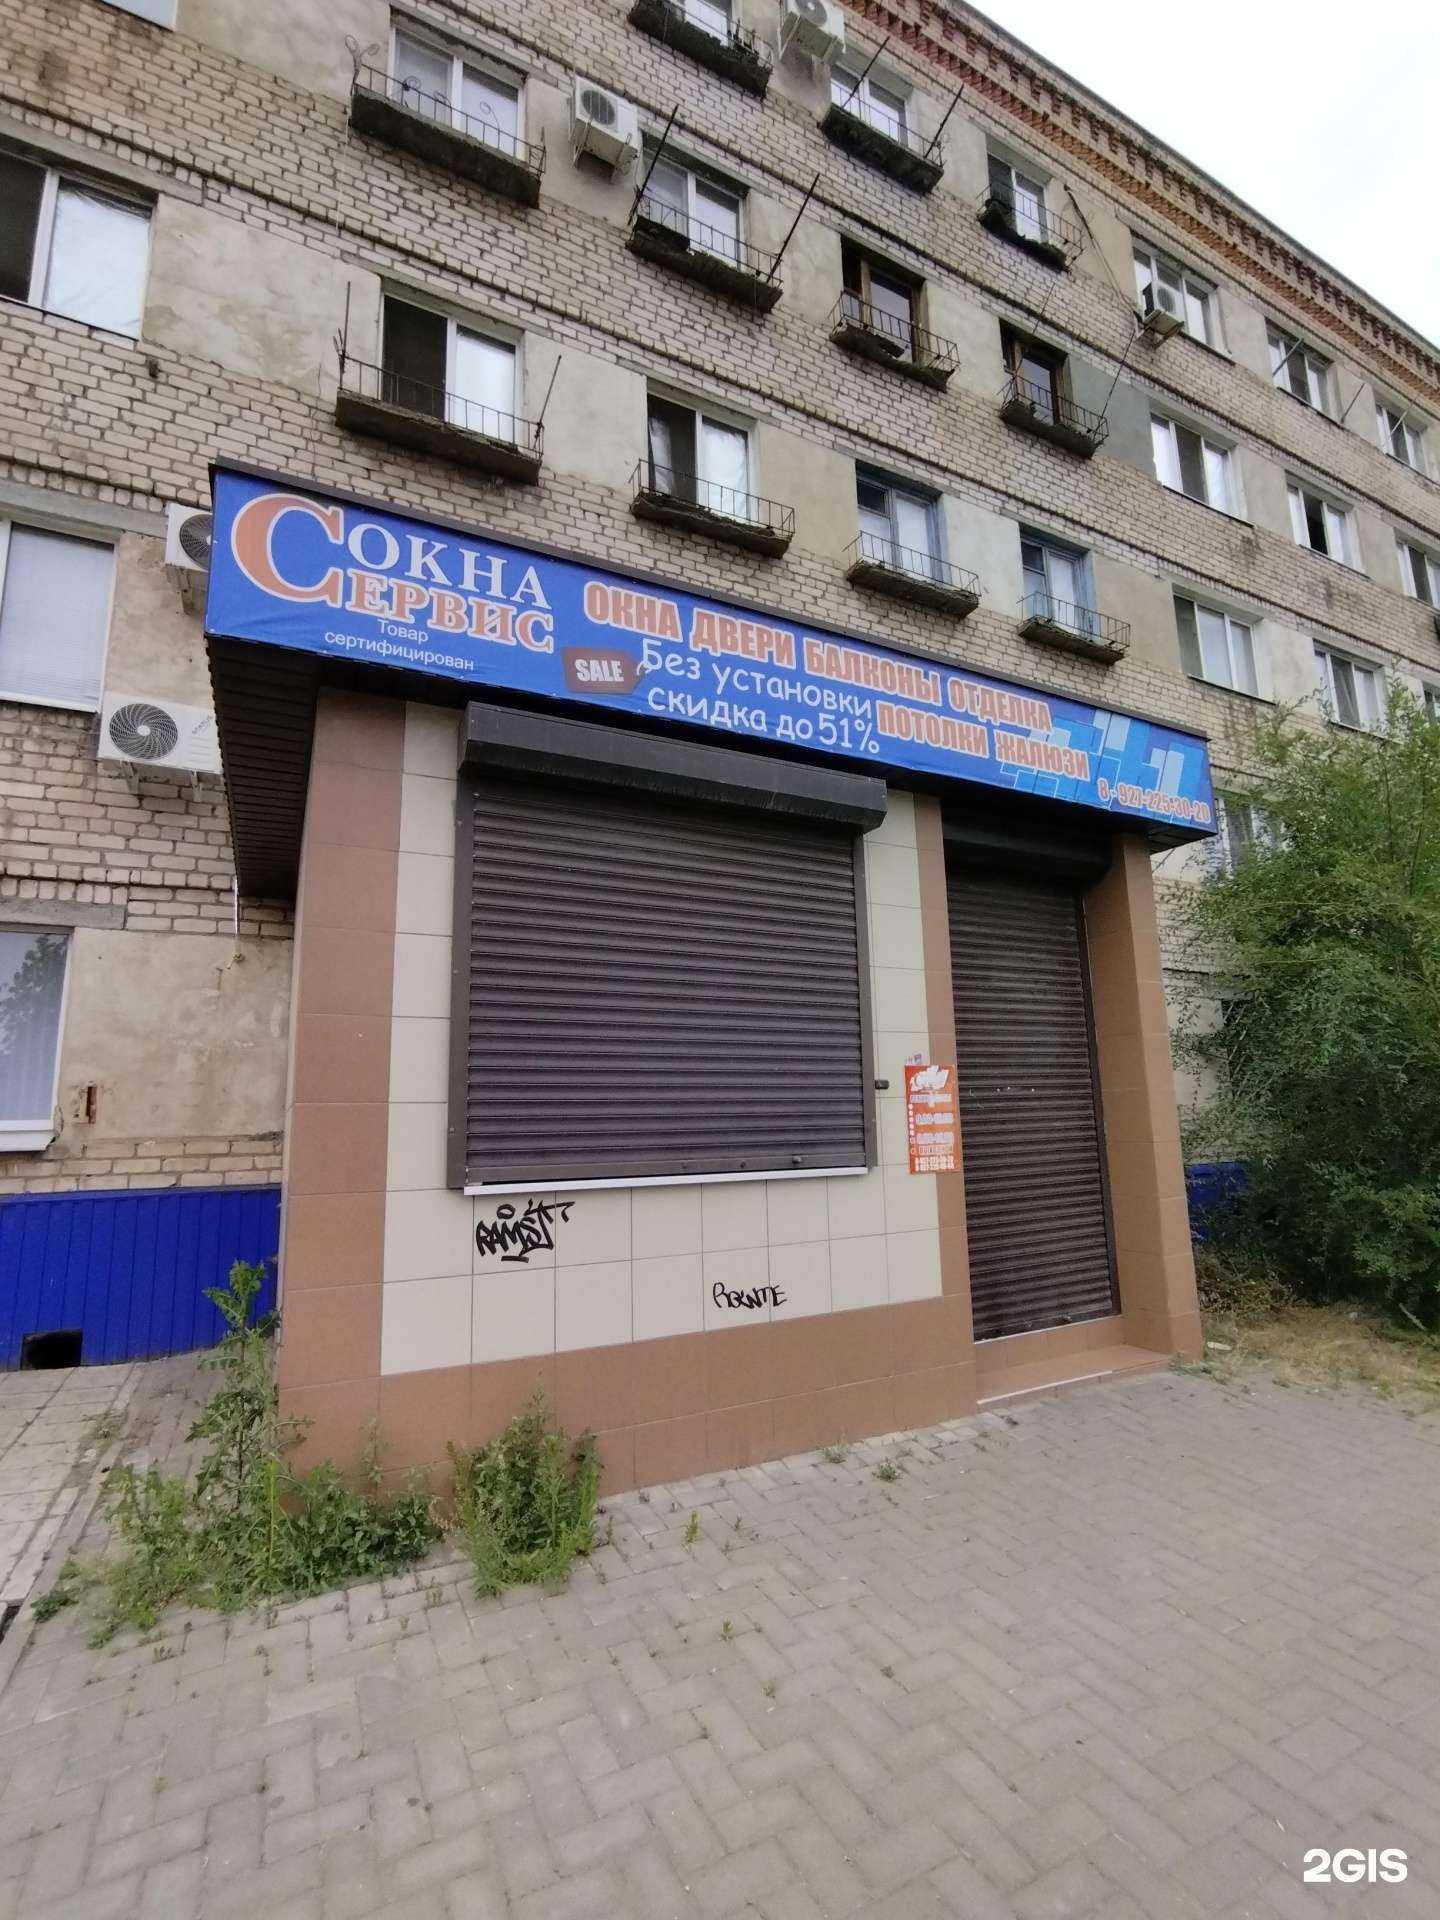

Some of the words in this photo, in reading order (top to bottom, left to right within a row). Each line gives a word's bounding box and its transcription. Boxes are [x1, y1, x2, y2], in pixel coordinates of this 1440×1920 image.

[324, 631, 475, 671] сертифицирован
[378, 619, 428, 645] Товар
[575, 658, 625, 682] SALE
[584, 581, 683, 643] ОКНА
[689, 607, 796, 670] ДВЕРИ
[803, 637, 942, 706] БАЛКОНЫ
[947, 677, 1053, 733] ОТДЕЛКА
[641, 638, 701, 680] Без
[711, 663, 872, 719] установки
[648, 687, 768, 733] скидка
[876, 700, 990, 758] ПОТОЛКИ
[993, 728, 1091, 782] ЖАЛЮЗИ
